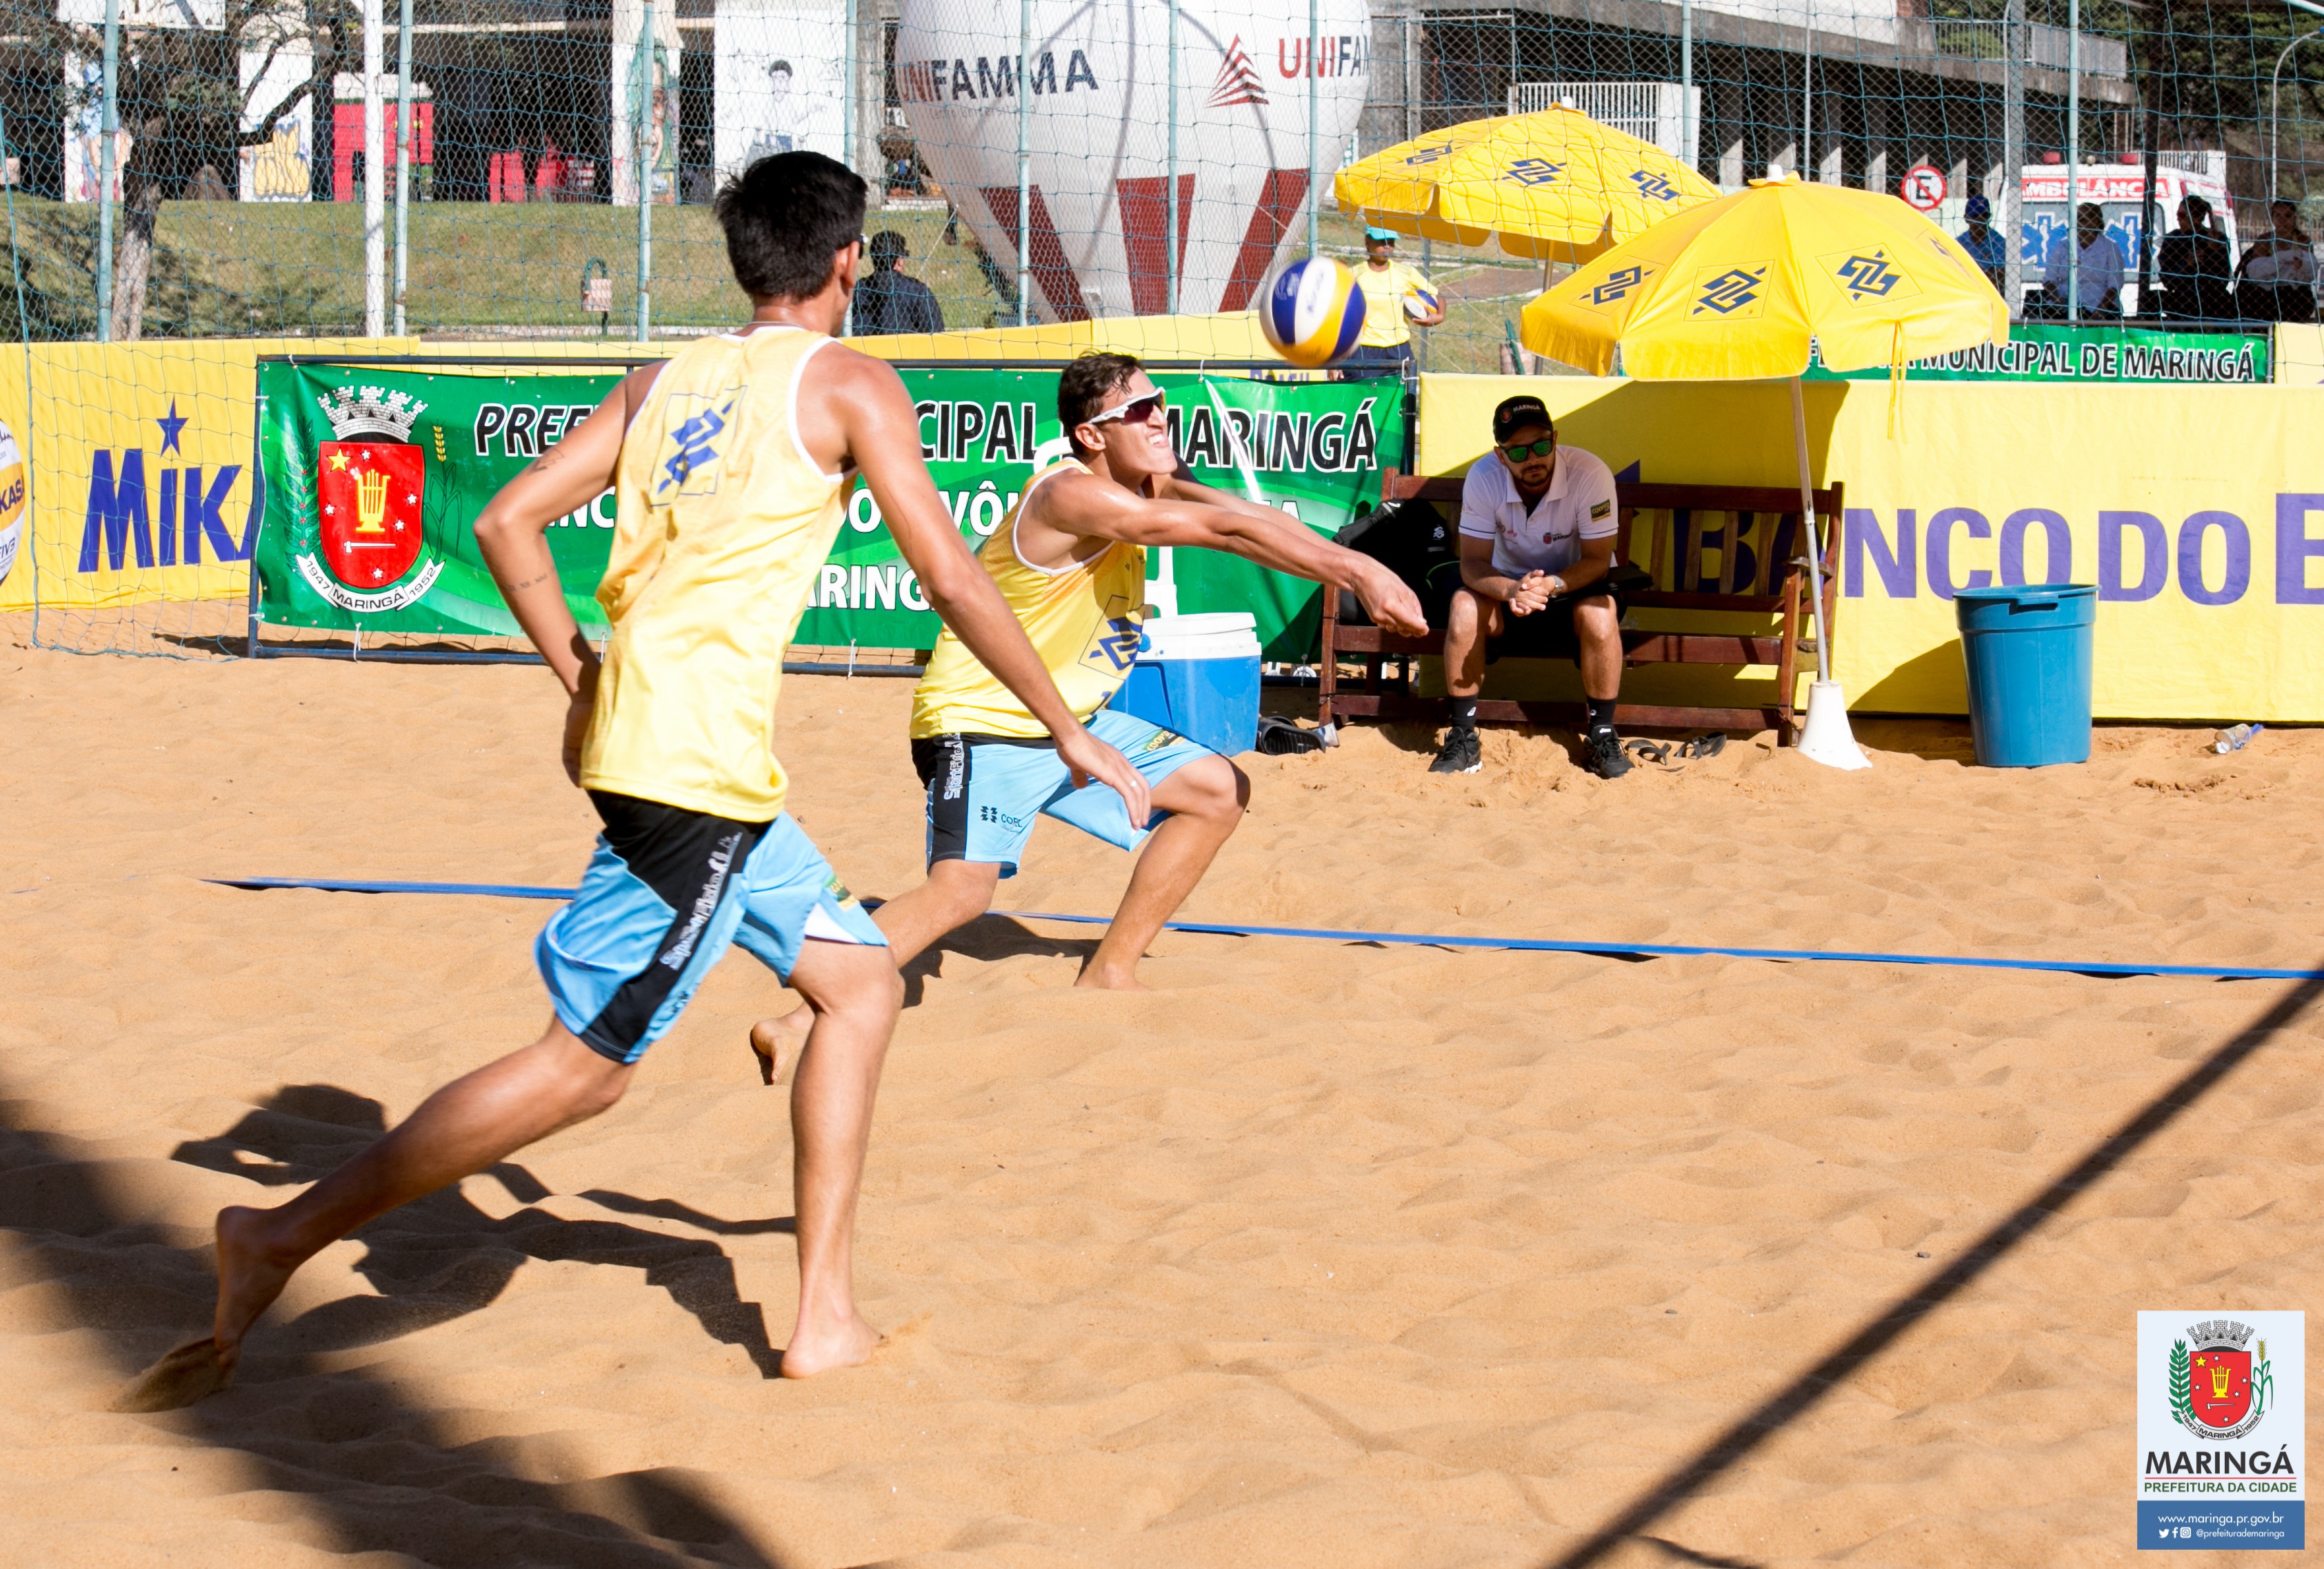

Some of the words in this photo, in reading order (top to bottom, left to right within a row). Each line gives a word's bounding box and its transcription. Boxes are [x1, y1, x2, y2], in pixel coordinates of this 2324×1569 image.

[2022, 179, 2168, 197] MBLÂNCA
[2080, 342, 2117, 377] DE
[2122, 343, 2256, 382] MARINGÁ
[2097, 510, 2251, 606] DO
[306, 561, 330, 590] 1947
[333, 589, 404, 610] MARINGÁ
[409, 567, 436, 597] 1952
